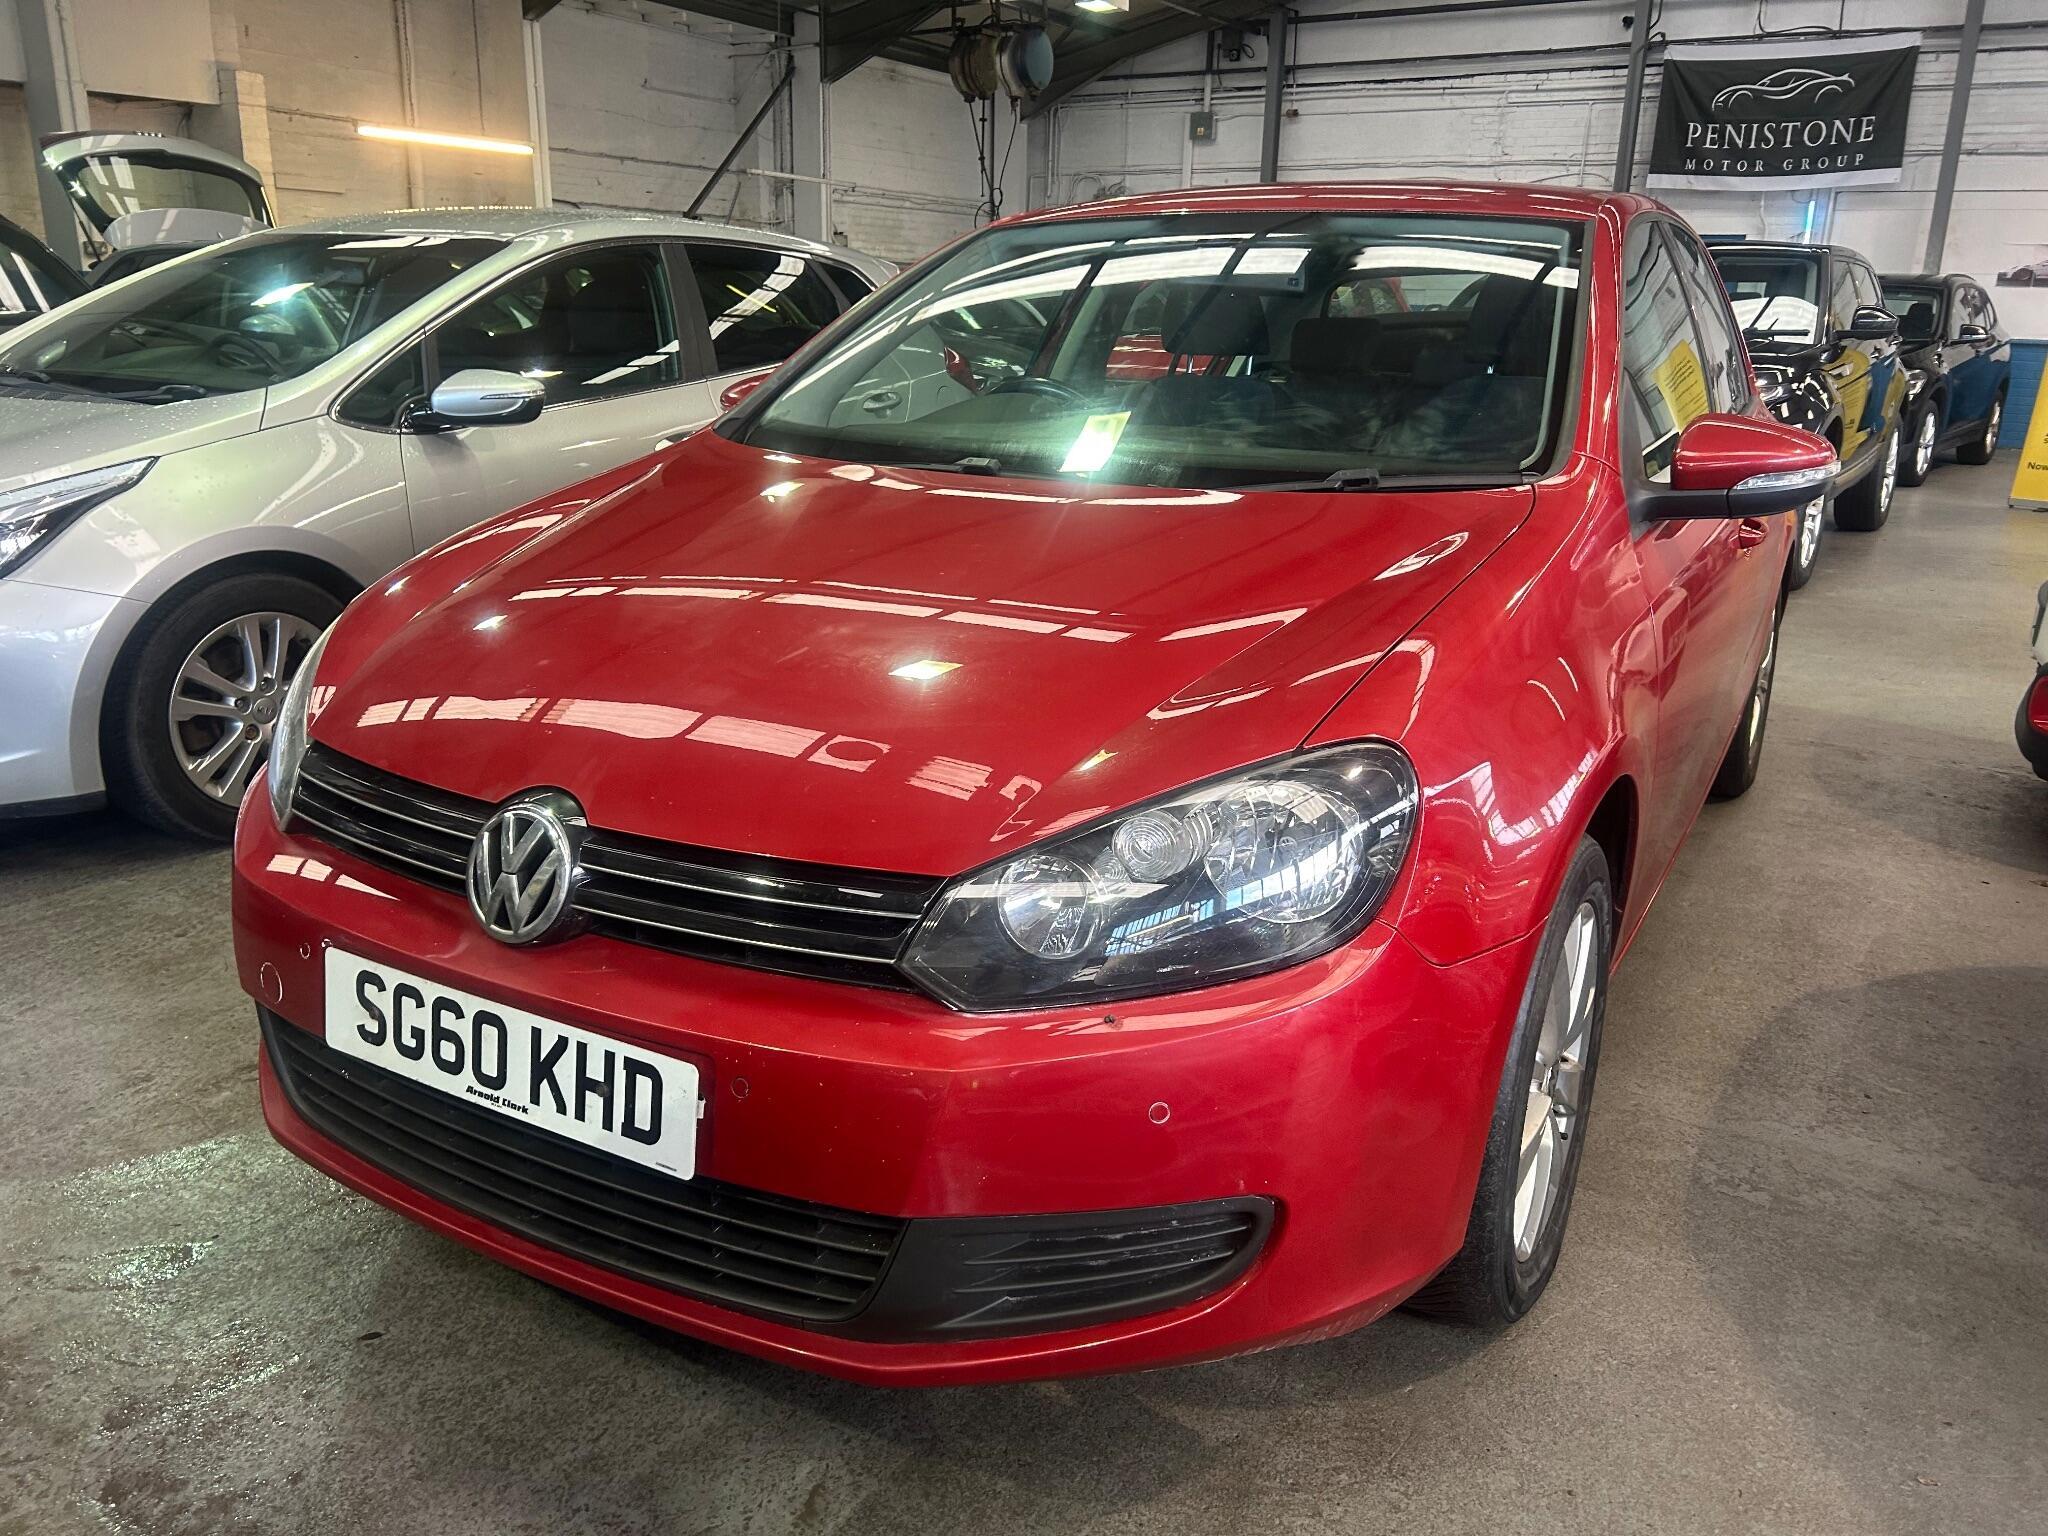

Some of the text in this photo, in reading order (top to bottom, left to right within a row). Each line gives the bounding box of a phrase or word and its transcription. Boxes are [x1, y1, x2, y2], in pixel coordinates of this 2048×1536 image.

[1685, 115, 1876, 149] PENISTONE
[1685, 153, 1864, 172] MOTOR GROUP
[355, 968, 664, 1147] SG60 KHD
[465, 1085, 529, 1115] Arnold Clark
